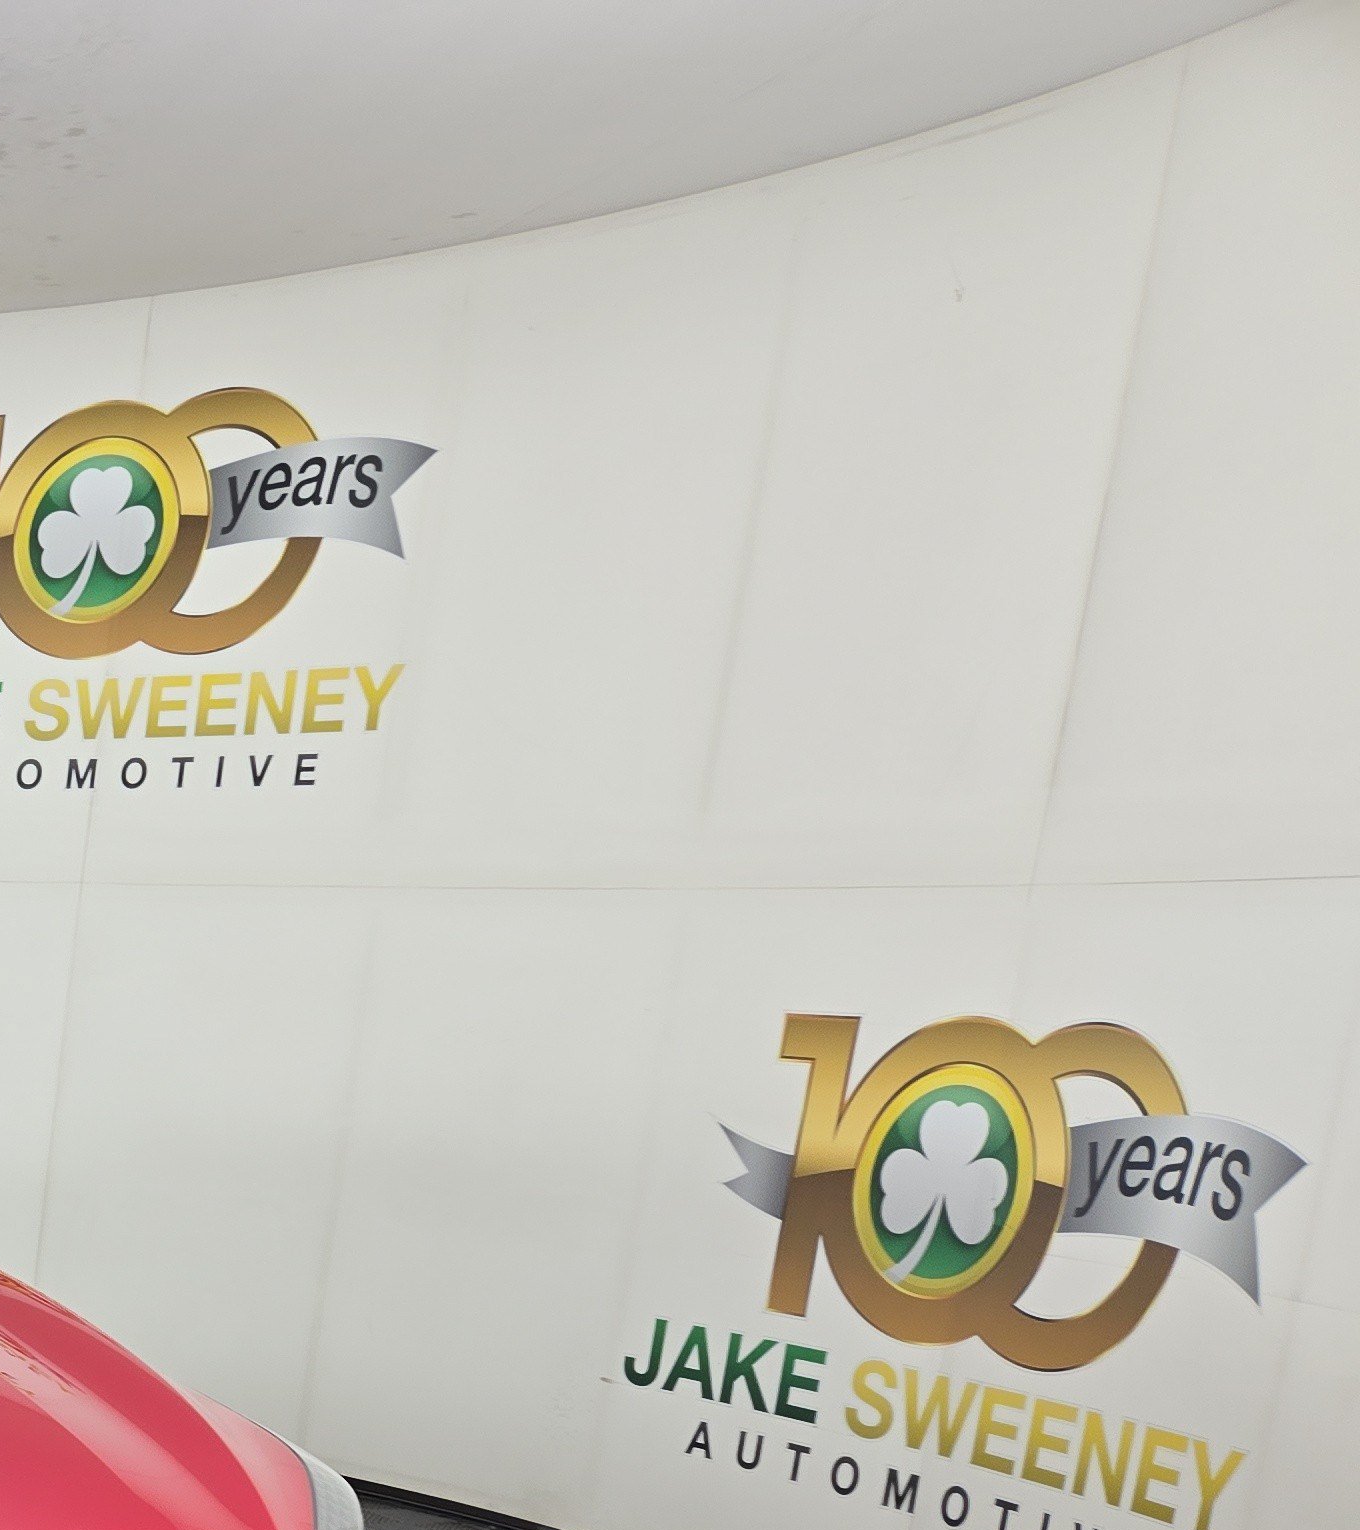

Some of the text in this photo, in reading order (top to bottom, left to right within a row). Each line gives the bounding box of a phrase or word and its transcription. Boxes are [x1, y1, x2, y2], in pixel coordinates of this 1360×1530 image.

[220, 451, 383, 533] years
[23, 662, 405, 742] SWEENEY
[766, 1013, 1251, 1372] 100 years
[623, 1317, 827, 1424] JAKE
